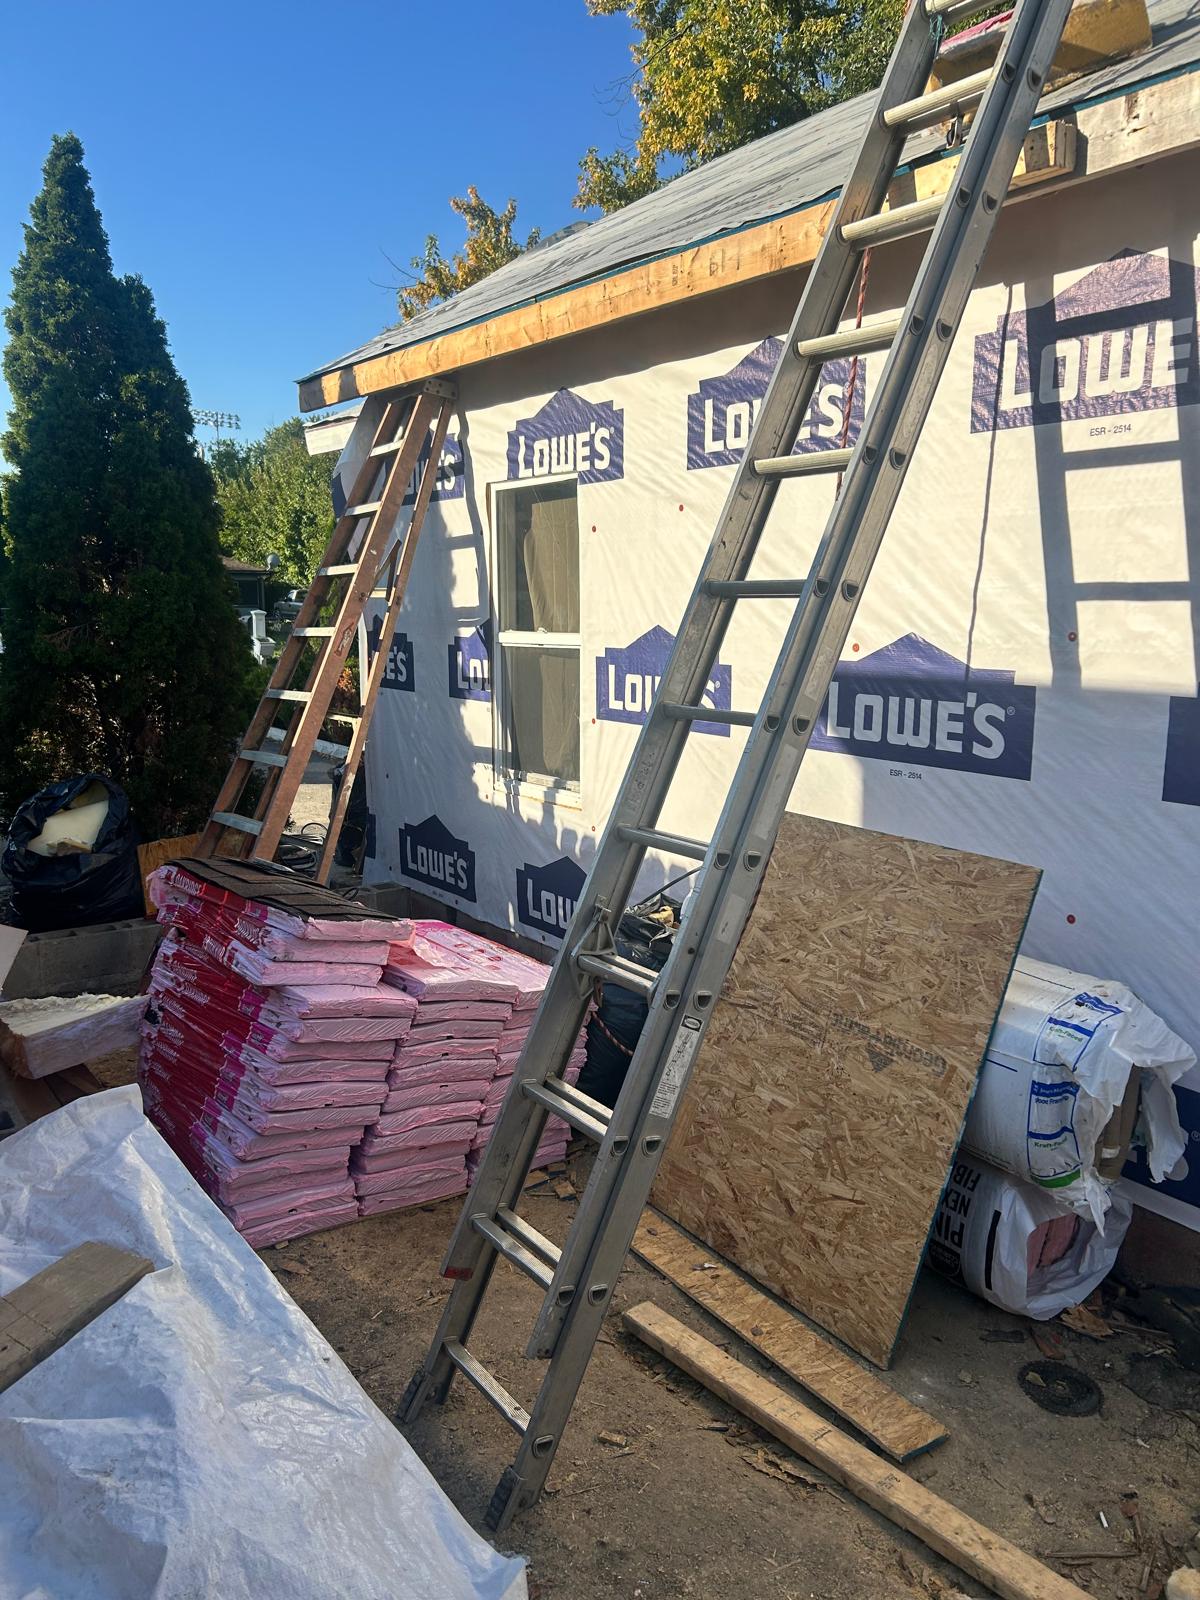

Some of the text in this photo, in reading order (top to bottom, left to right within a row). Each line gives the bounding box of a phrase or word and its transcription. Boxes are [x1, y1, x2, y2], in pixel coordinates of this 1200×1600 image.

[518, 422, 612, 477] LOWE'S
[1089, 426, 1106, 437] ESR
[1113, 424, 1132, 434] 2514
[827, 682, 1006, 760] LOWE'S
[889, 769, 903, 778] ESR
[908, 771, 922, 780] 2514
[406, 836, 468, 890] LOWE'S
